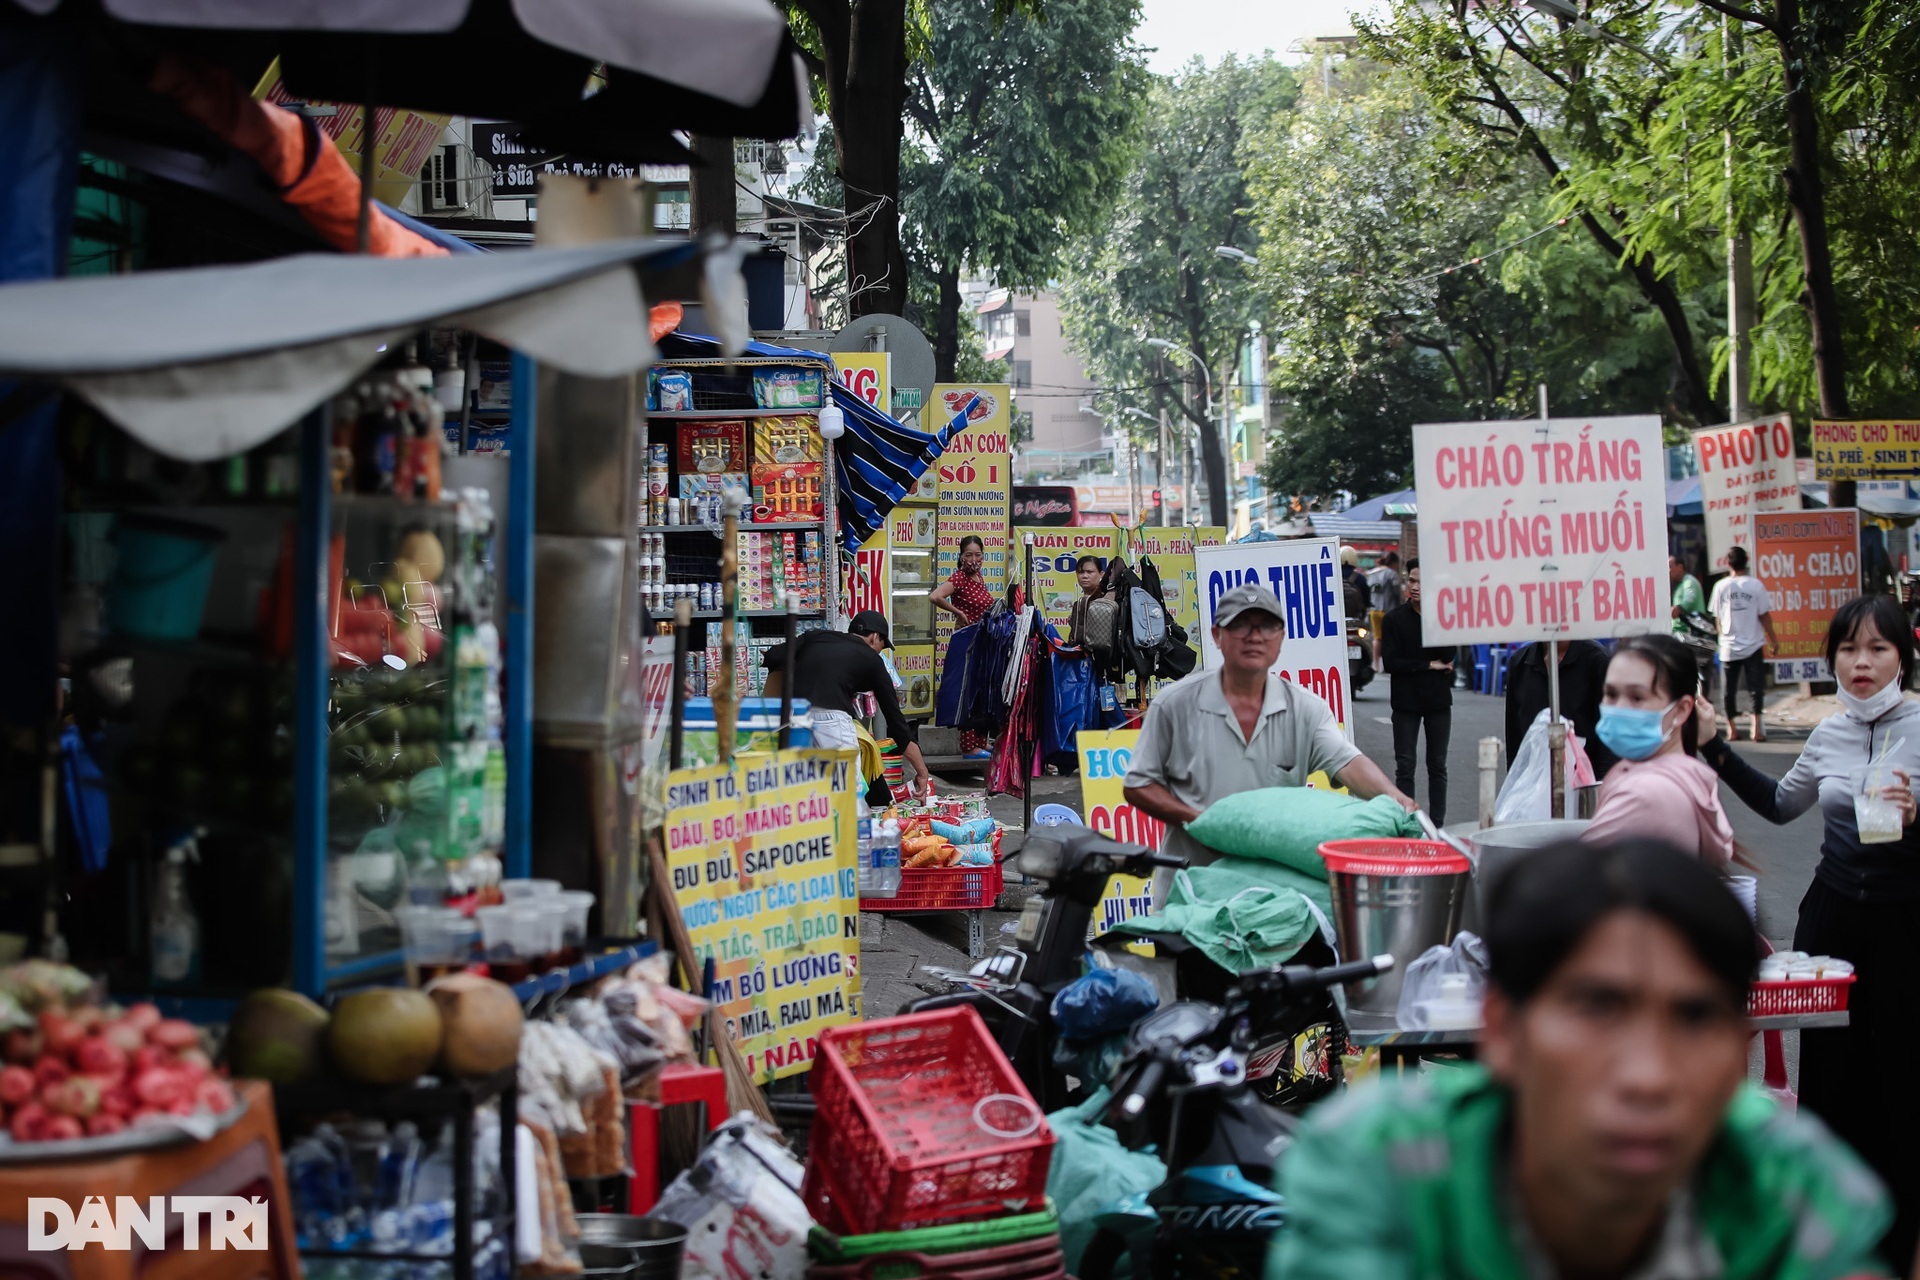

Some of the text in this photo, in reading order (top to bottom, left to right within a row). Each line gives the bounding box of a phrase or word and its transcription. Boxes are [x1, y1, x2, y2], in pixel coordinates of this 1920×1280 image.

[977, 430, 1007, 454] CƠM
[1699, 421, 1790, 474] PHOTO
[1862, 424, 1888, 443] CHO
[939, 456, 977, 484] SỐ
[987, 465, 999, 484] 1
[1435, 423, 1643, 491] CHÁO TRẮNG
[1874, 450, 1907, 463] SINH
[896, 512, 914, 542] PHỞ
[974, 506, 988, 516] NON
[990, 506, 1004, 516] KHO
[1441, 489, 1645, 564] TRỨNG MUỐI
[937, 535, 952, 547] CƠM
[1073, 533, 1111, 548] CƠM
[1758, 549, 1797, 579] CƠM
[1807, 545, 1857, 578] CHÁO
[1268, 546, 1339, 640] THUÊ
[1437, 561, 1657, 632] CHÁO THỊT BẦM
[668, 780, 710, 809] SINH
[783, 755, 831, 786] KHÁT
[673, 864, 700, 891] ĐU
[744, 835, 833, 875] SAPOCHE
[766, 880, 798, 911] CÁC
[801, 873, 836, 904] LOẠI
[773, 951, 842, 987] LƯỢNG
[780, 998, 812, 1027] RAU
[817, 986, 845, 1018] MÁ
